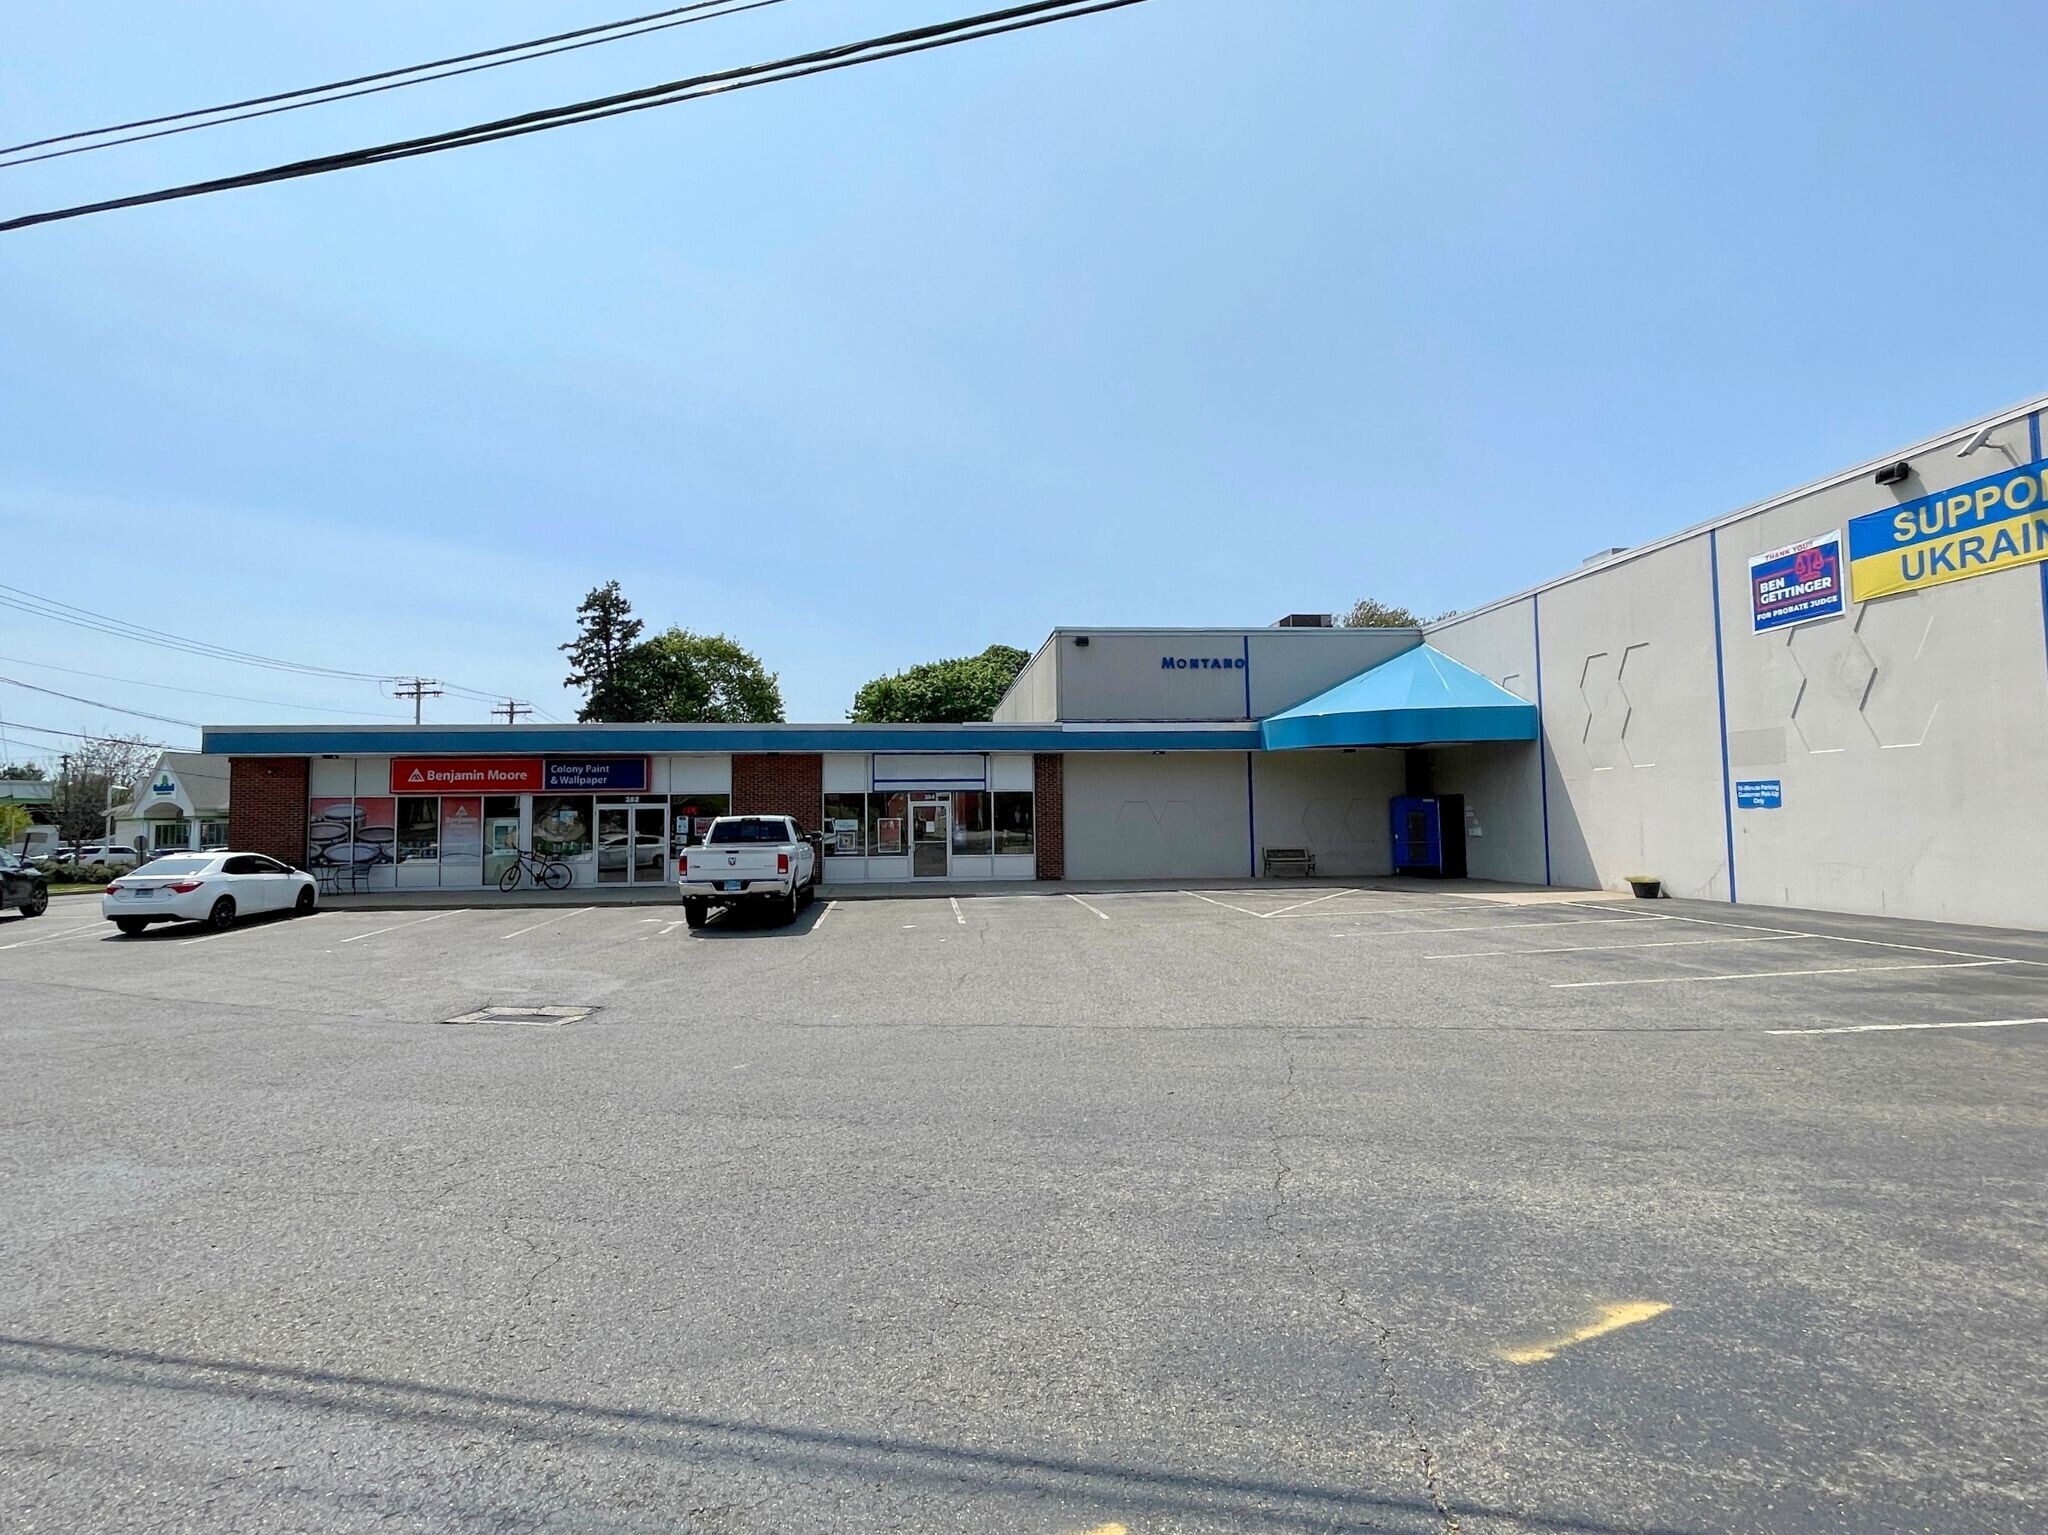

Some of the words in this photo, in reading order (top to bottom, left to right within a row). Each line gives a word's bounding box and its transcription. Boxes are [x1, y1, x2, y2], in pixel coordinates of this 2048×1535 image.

[1764, 549, 1790, 561] THANK
[1760, 577, 1785, 594] BEN
[1761, 576, 1832, 605] GETTINGER
[1756, 611, 1772, 621] FOR
[1773, 602, 1809, 617] PROBATE
[1810, 595, 1837, 608] JUDGE
[1161, 656, 1247, 670] MONTANO
[427, 769, 485, 784] Benjamin
[487, 769, 528, 781] Moore
[550, 764, 584, 775] Colony
[585, 764, 610, 773] Paint
[550, 775, 558, 785] &
[559, 775, 608, 786] Wallpaper
